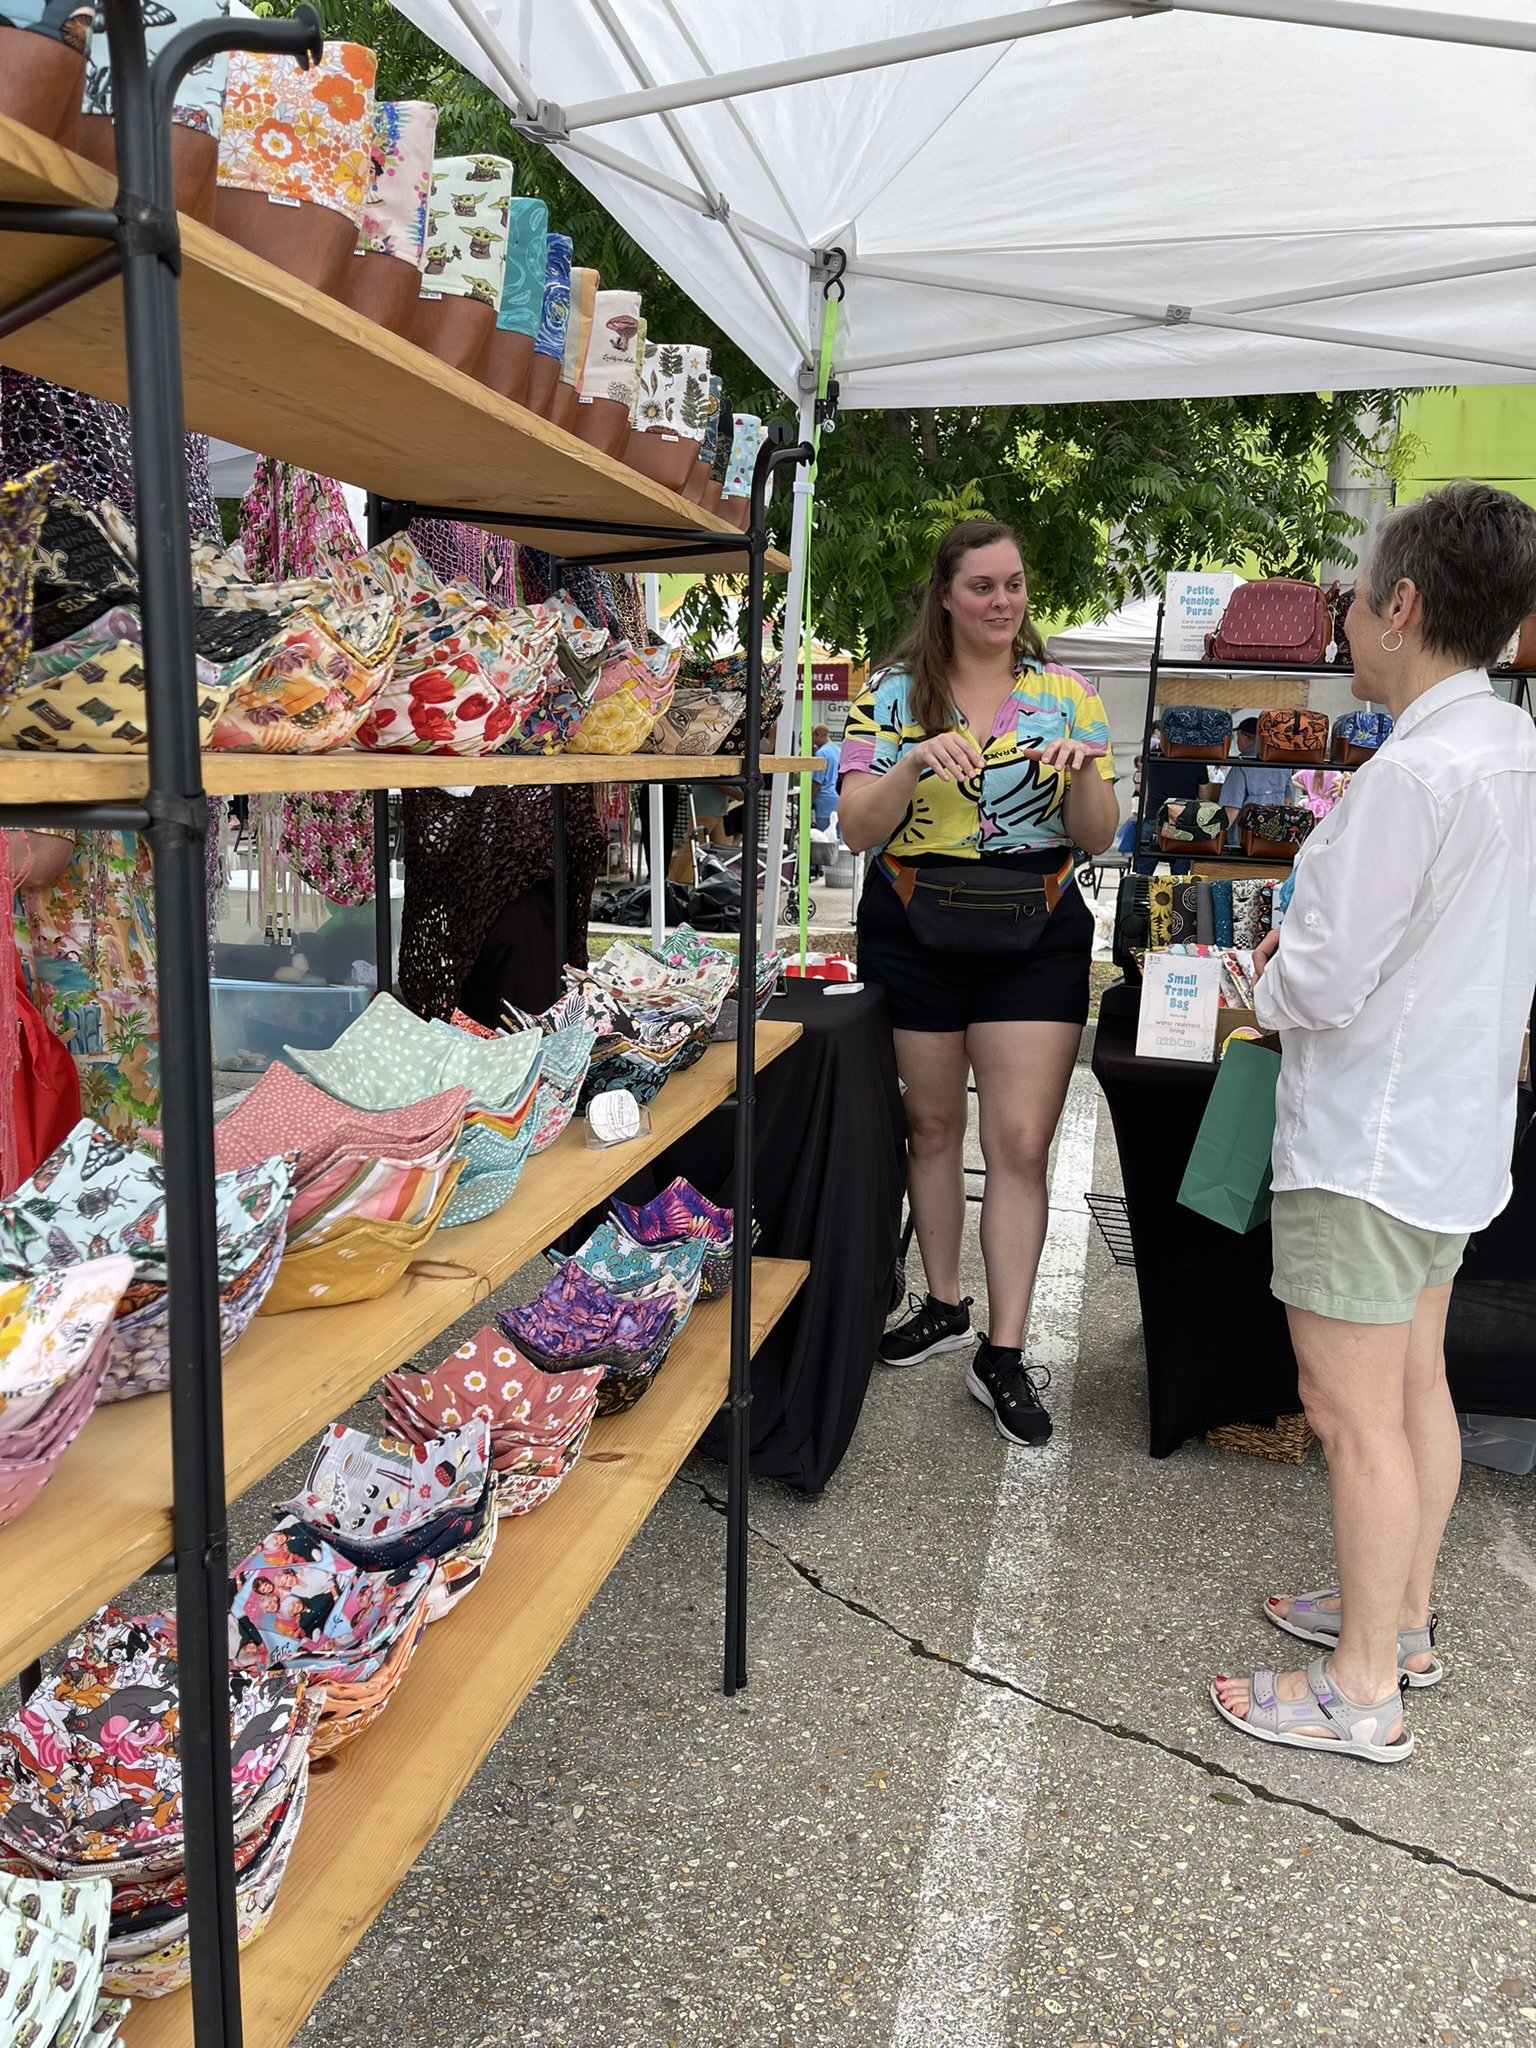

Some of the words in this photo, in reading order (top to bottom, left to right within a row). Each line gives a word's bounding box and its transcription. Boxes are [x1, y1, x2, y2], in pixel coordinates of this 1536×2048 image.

[1186, 585, 1214, 595] Petite
[1180, 595, 1220, 607] Penelope
[1186, 606, 1213, 616] Purse
[824, 674, 835, 682] AT
[1167, 973, 1197, 985] Small
[1165, 985, 1198, 998] Travel
[1169, 998, 1190, 1011] Bag
